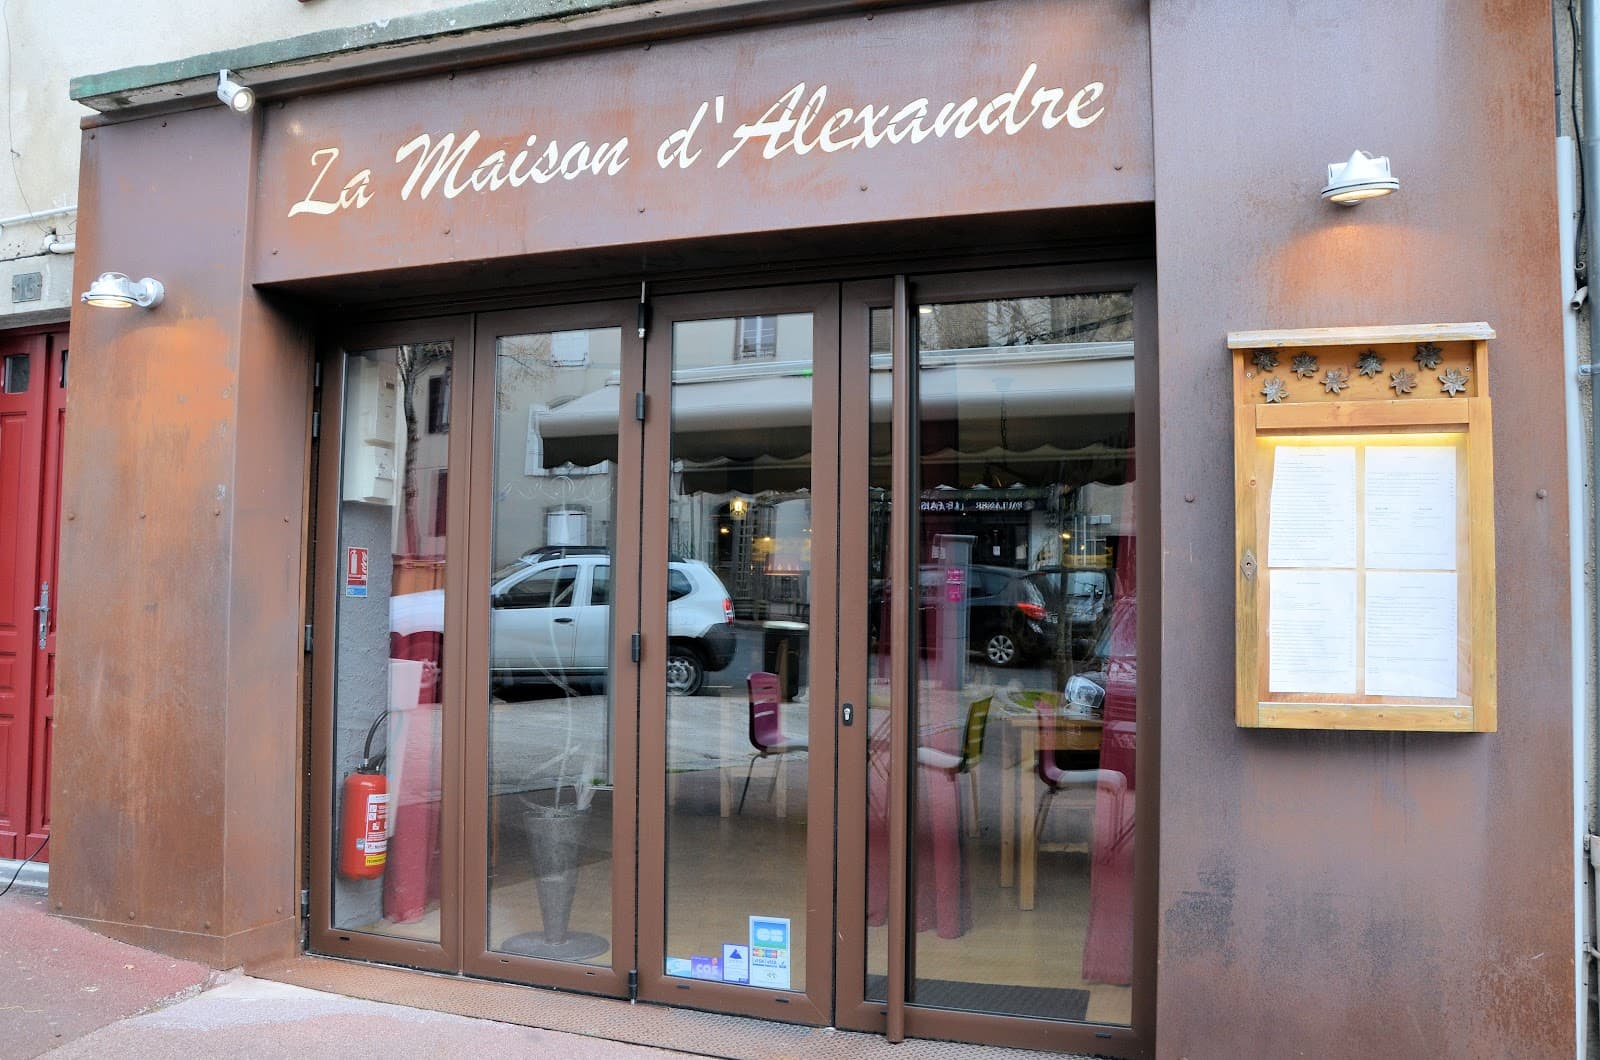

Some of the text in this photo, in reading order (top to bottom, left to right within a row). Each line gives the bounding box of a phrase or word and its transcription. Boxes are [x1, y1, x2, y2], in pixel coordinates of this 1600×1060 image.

[288, 62, 1105, 218] La Maison d'Alexandre
